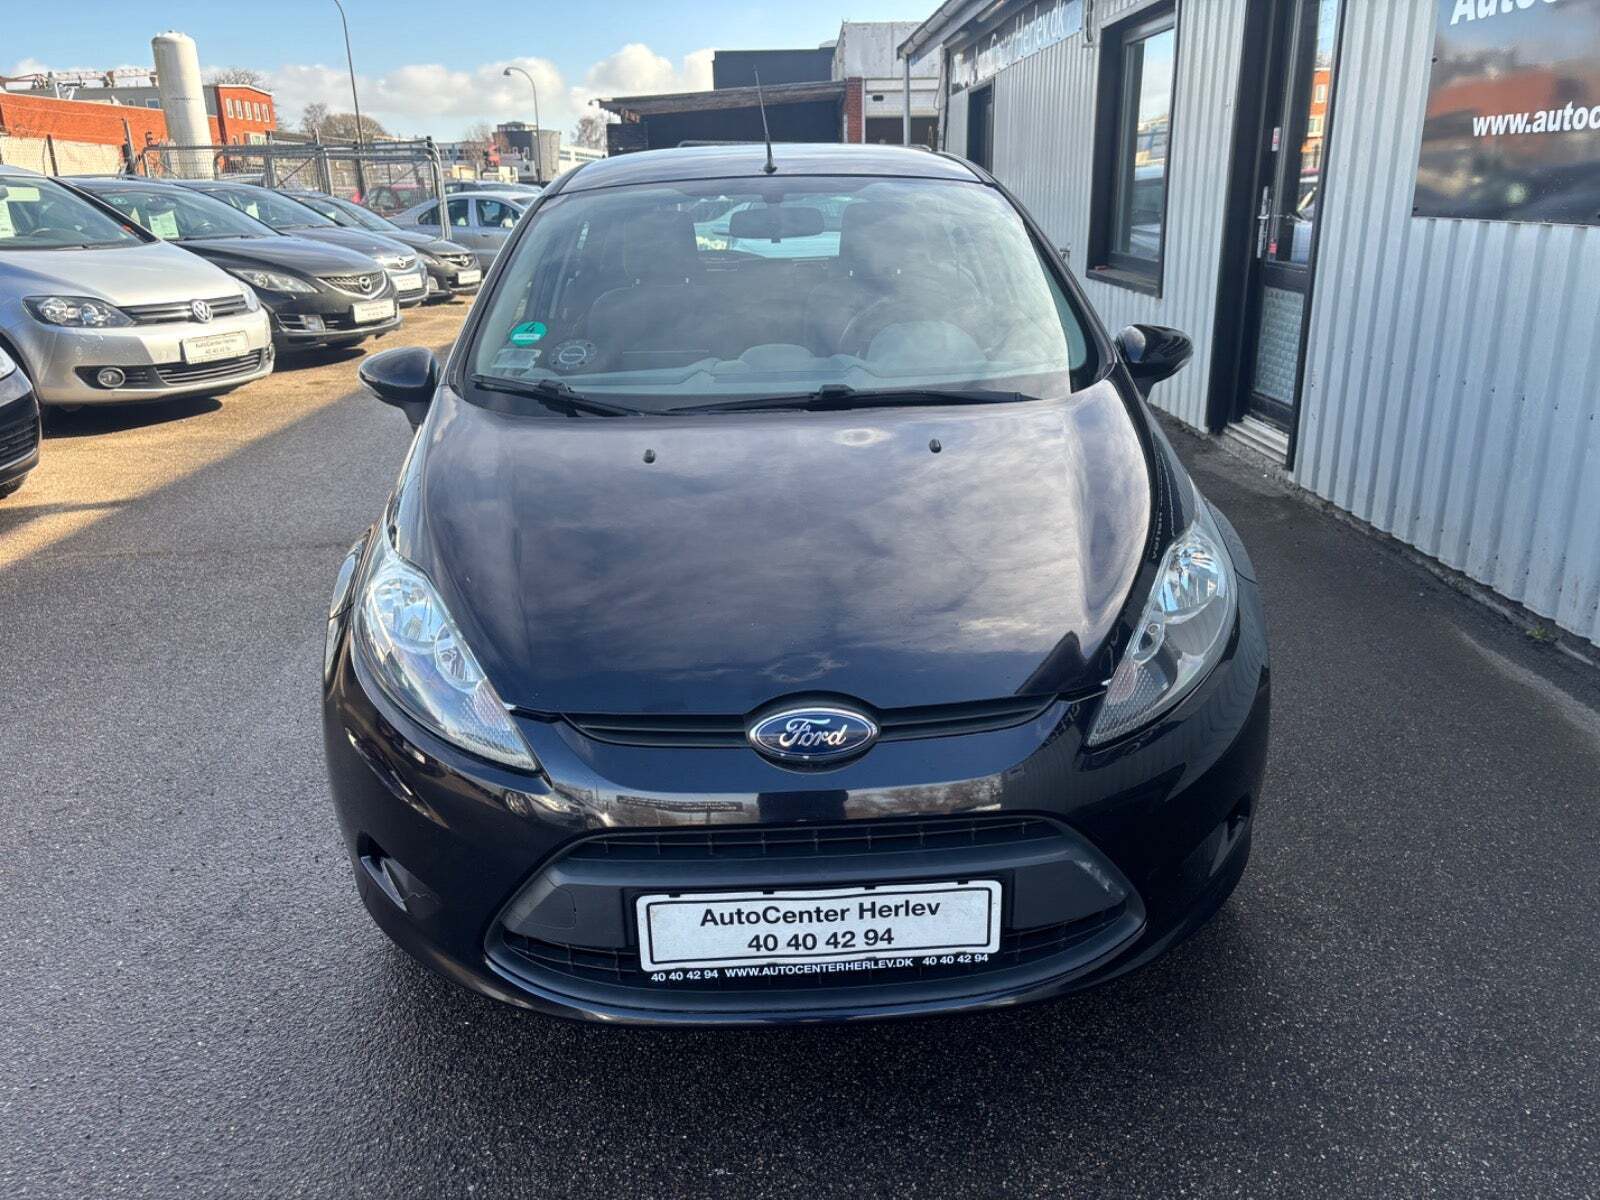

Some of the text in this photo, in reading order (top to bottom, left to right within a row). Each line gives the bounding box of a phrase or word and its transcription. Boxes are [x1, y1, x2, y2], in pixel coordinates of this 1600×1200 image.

[779, 718, 848, 747] Ford
[700, 899, 941, 927] AutoCenter Herlev
[747, 927, 894, 952] 40 40 42 94
[650, 952, 989, 982] 40 40 42 94 WWW.AUTOCENTERHERLEV.DK 40 40 42 94
